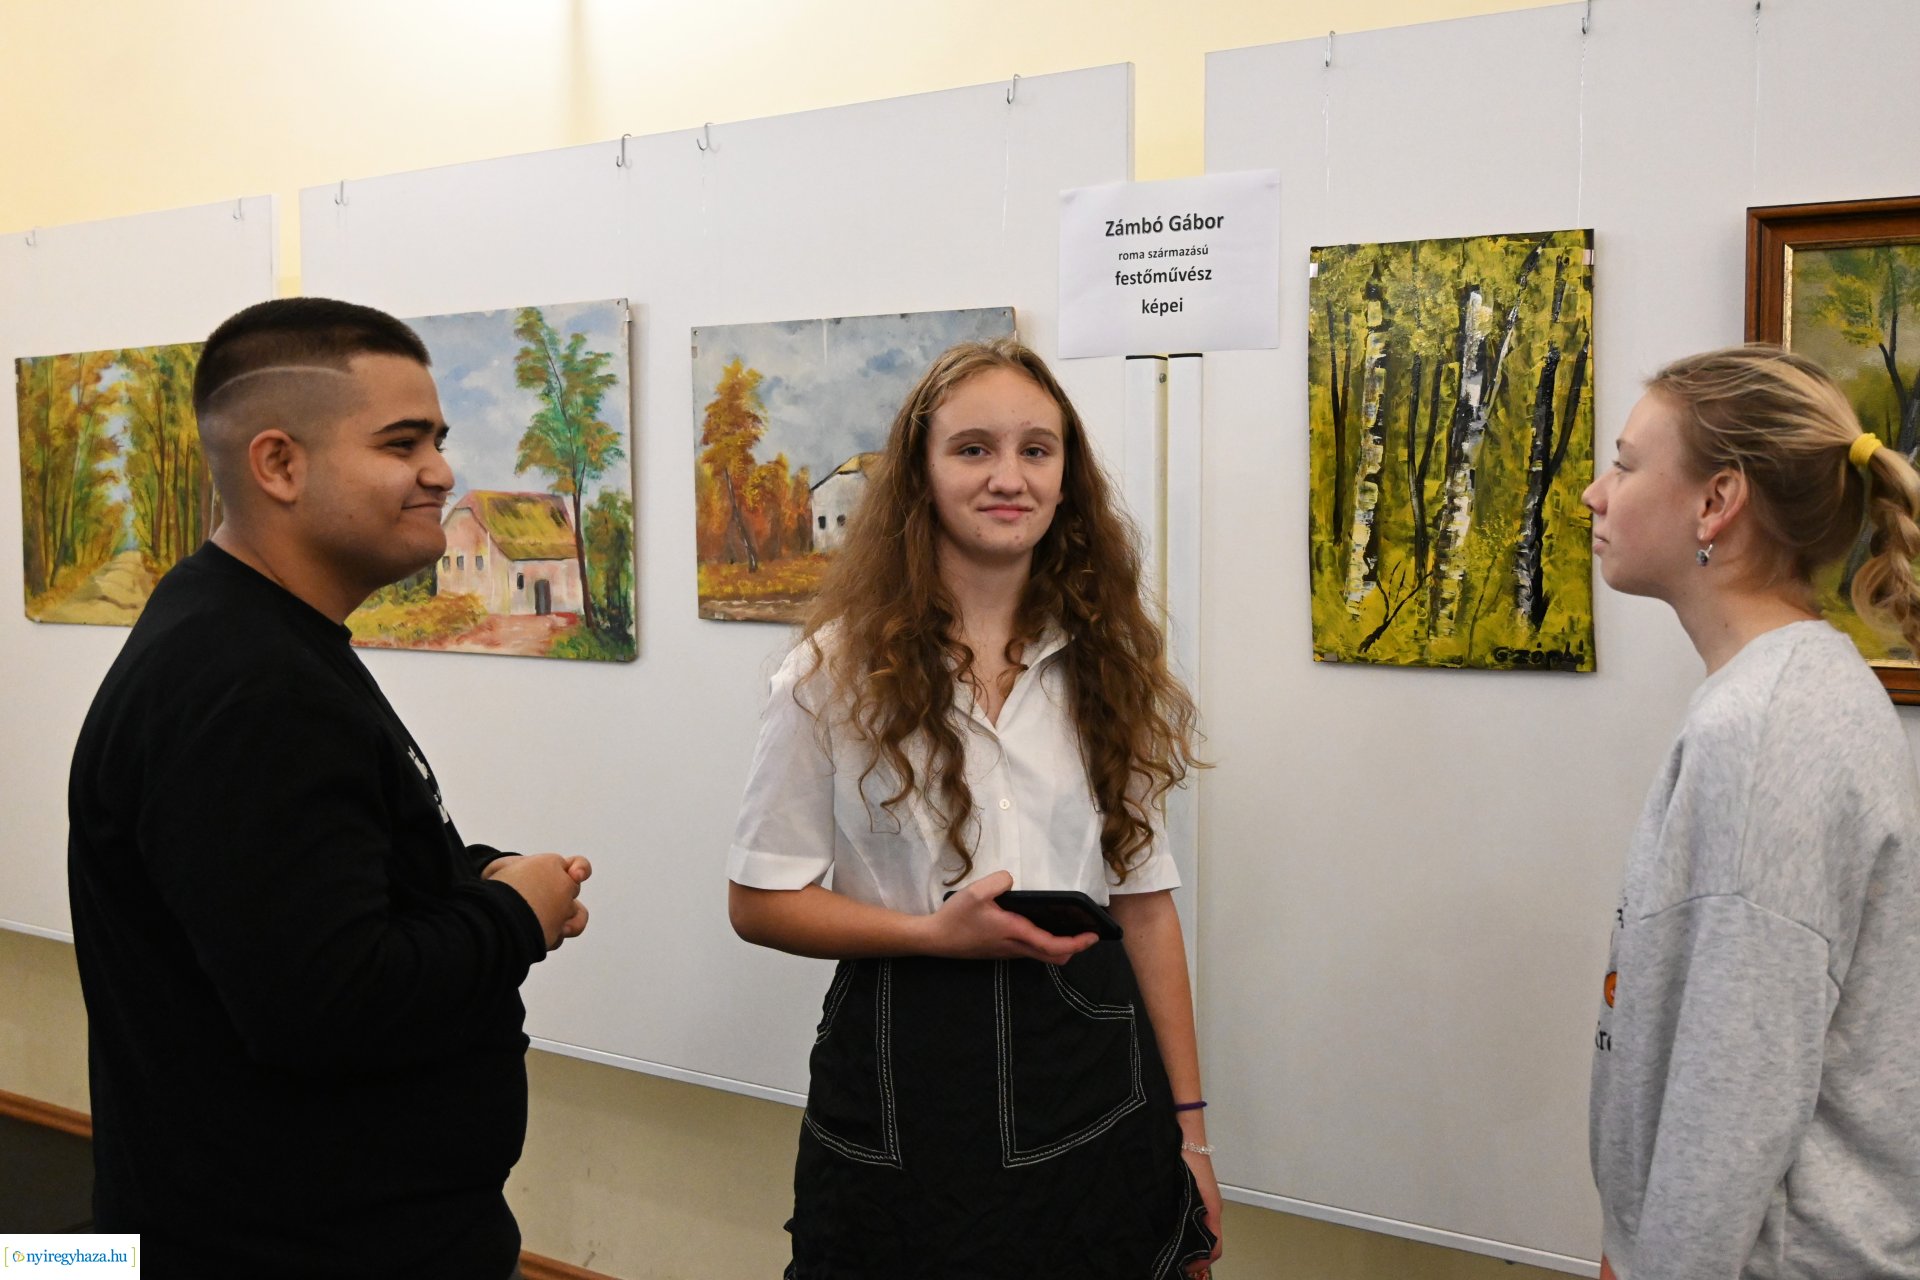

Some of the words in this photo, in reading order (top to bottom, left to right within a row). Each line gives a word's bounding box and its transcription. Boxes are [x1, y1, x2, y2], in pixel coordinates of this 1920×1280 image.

[1105, 215, 1164, 237] Zámbó
[1168, 213, 1225, 232] Gábor
[1118, 251, 1145, 261] roma
[1147, 244, 1209, 259] származású
[1114, 265, 1213, 286] festőművész
[1141, 297, 1183, 317] képei
